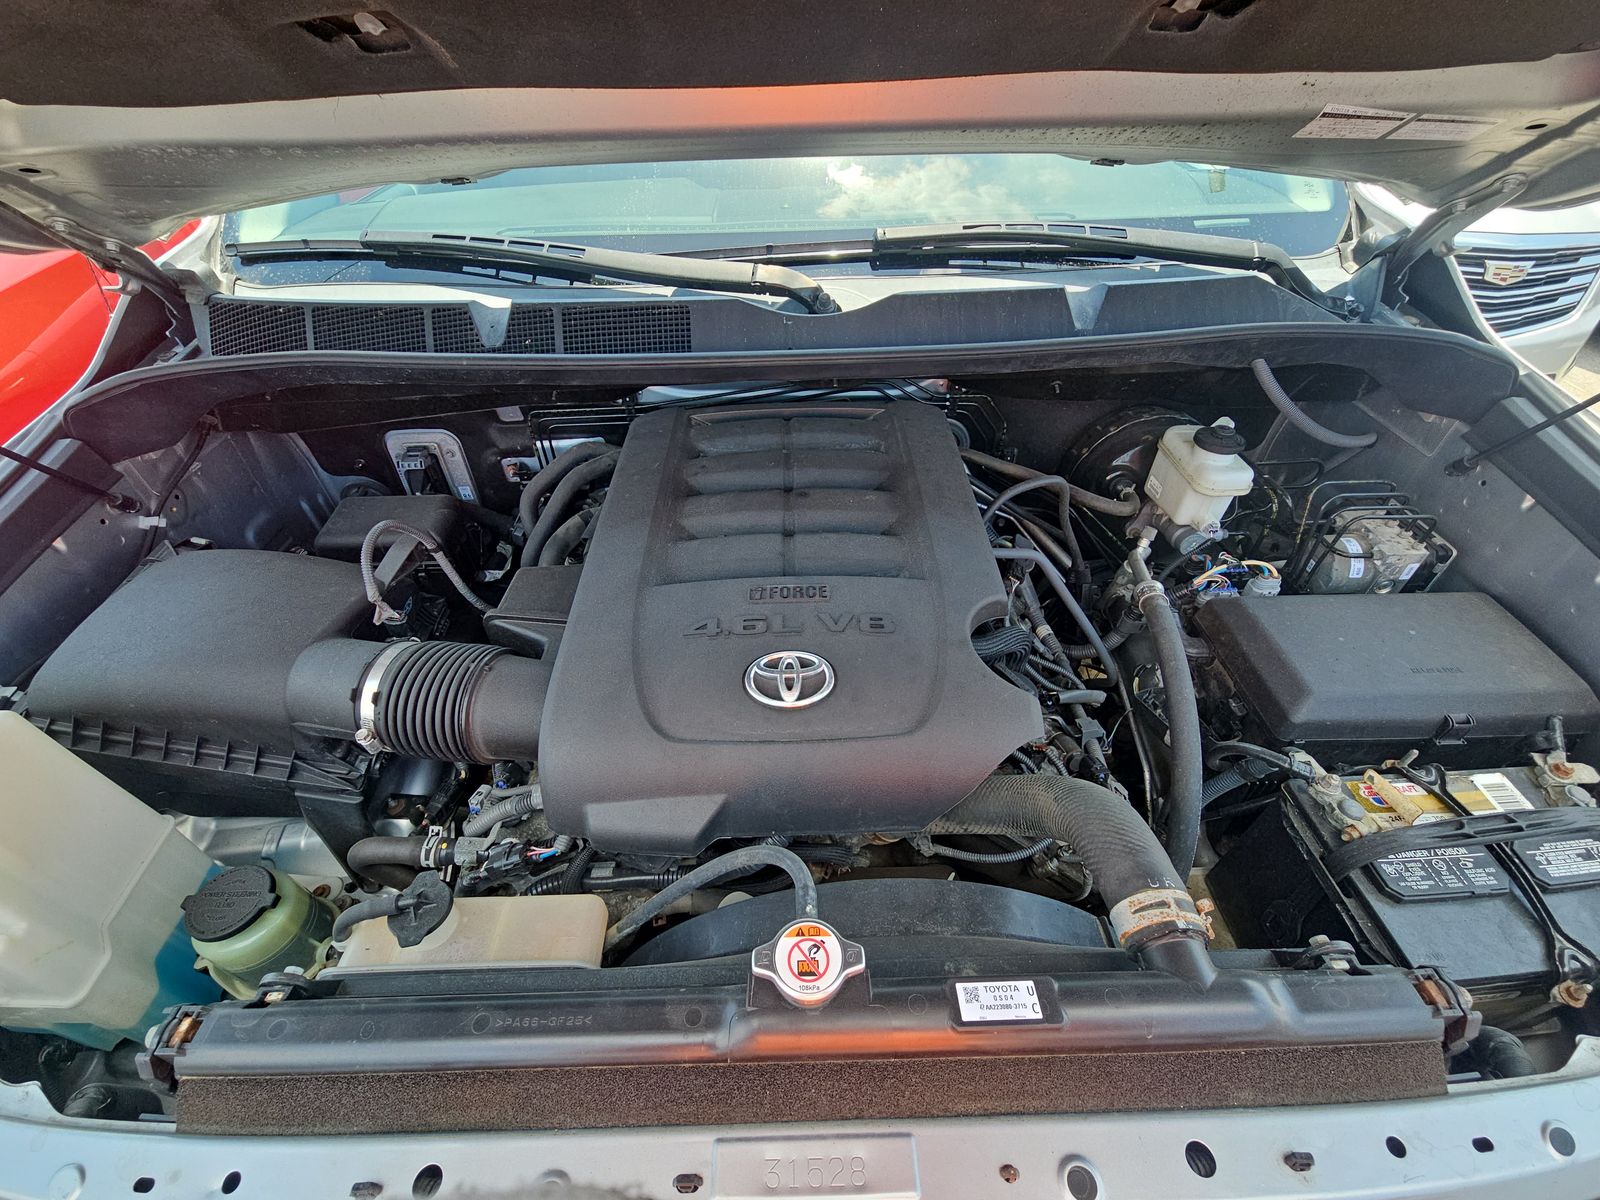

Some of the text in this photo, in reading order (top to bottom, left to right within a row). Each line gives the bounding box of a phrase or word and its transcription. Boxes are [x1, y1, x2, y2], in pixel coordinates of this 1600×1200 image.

[682, 612, 898, 638] 4.6L V8
[1395, 849, 1429, 859] DANGER
[1436, 846, 1469, 857] POISON
[983, 984, 1035, 997] TOYOTA U
[1031, 1002, 1040, 1014] C
[763, 1155, 867, 1190] 31528
